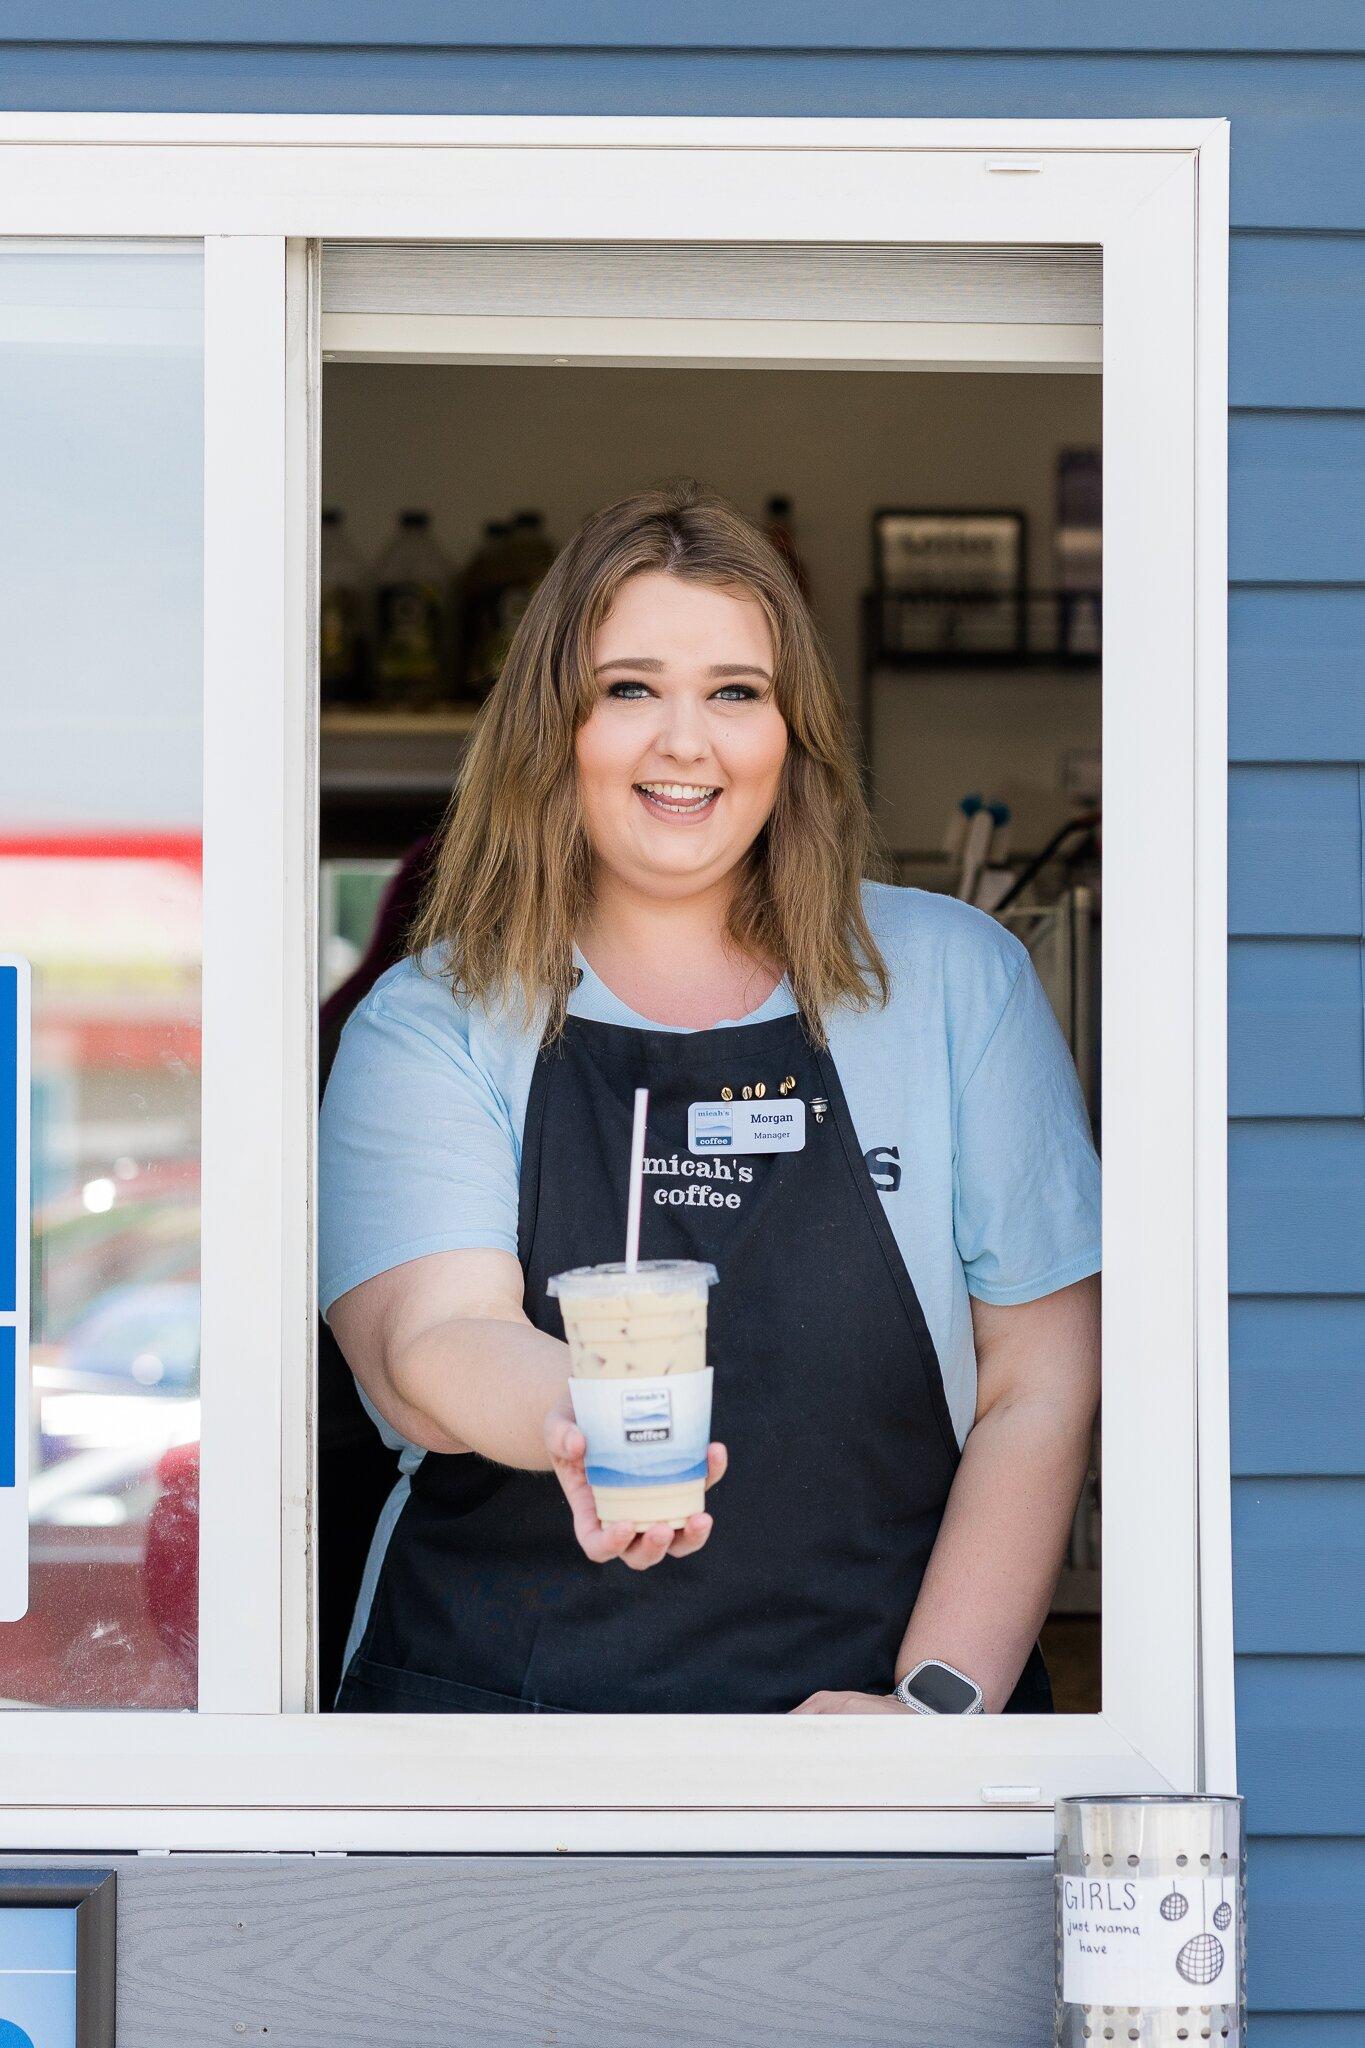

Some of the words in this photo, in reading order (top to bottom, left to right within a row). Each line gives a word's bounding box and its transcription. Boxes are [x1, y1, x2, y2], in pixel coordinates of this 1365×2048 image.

[750, 1113, 794, 1124] Morgan
[699, 1137, 729, 1145] coffee
[754, 1132, 790, 1142] Manager
[642, 1154, 754, 1183] micah's
[653, 1185, 741, 1209] coffee
[629, 1430, 667, 1442] coffee
[1064, 1881, 1136, 1911] GIRLS
[1067, 1919, 1089, 1936] just
[1095, 1924, 1141, 1935] wanna
[1079, 1939, 1107, 1955] have
